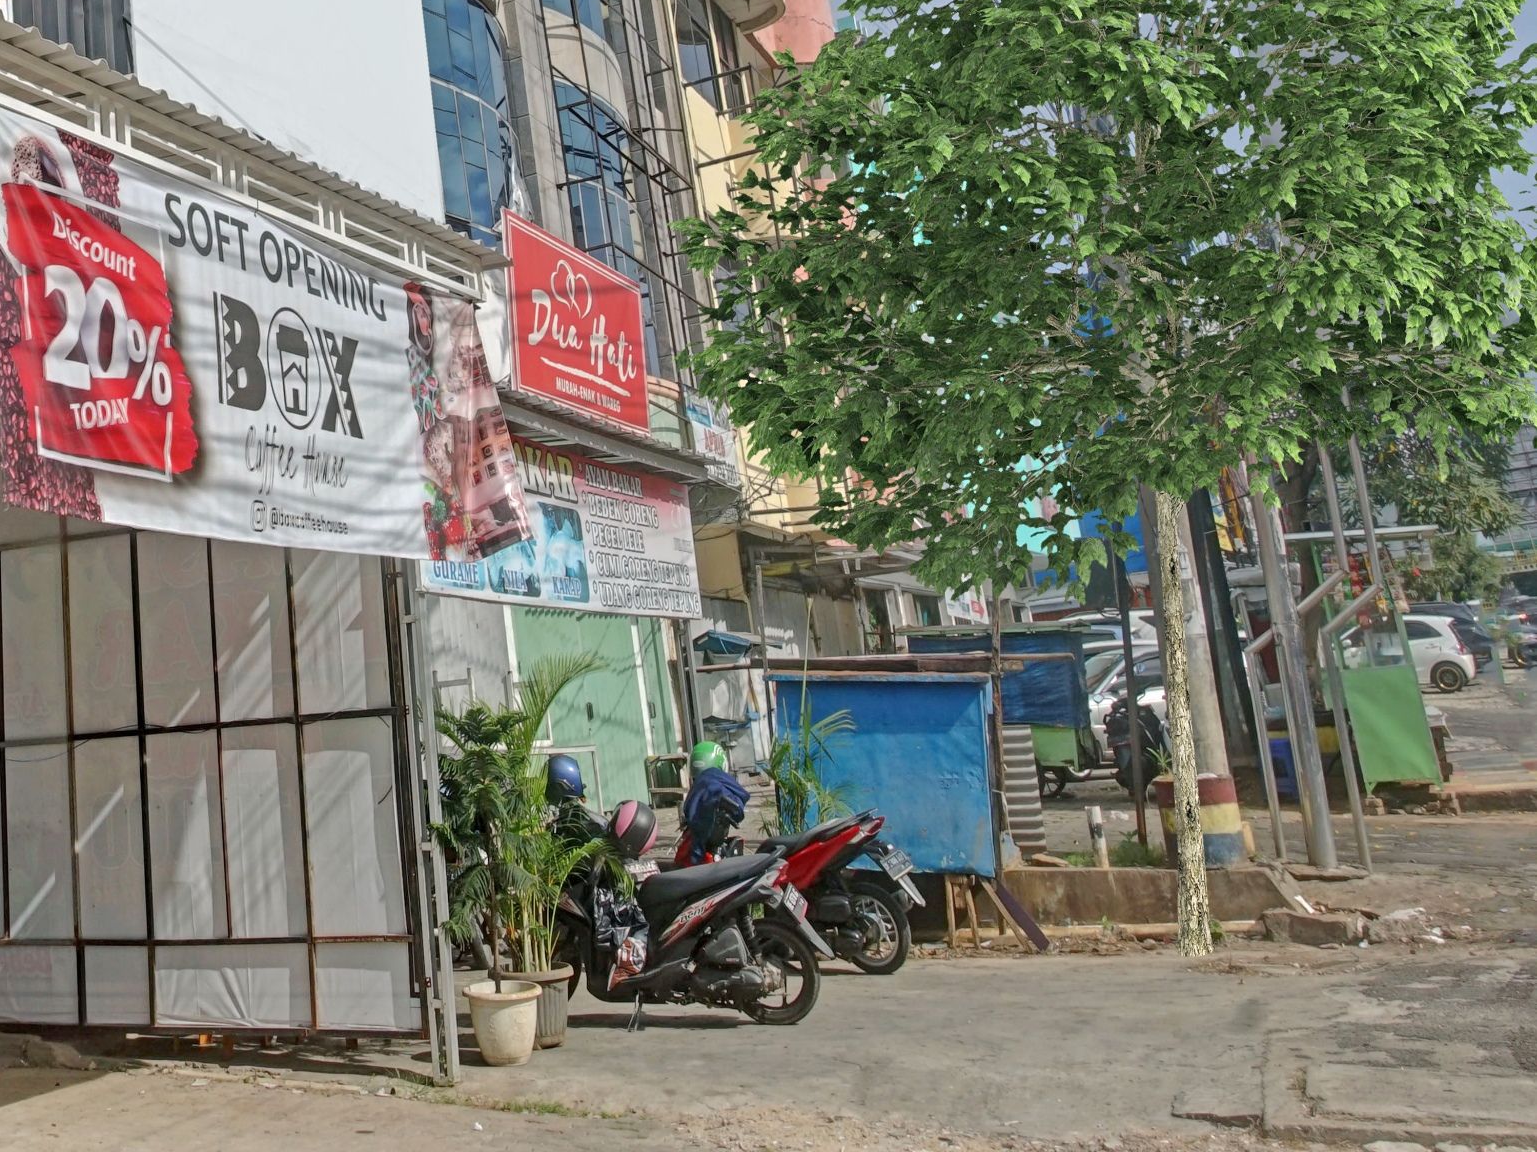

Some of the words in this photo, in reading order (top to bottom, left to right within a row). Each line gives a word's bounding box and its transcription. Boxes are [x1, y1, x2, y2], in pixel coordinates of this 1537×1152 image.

[52, 210, 136, 281] Discount
[164, 192, 248, 271] SOFT
[259, 230, 387, 322] OPENING
[43, 265, 172, 406] 20%
[528, 289, 583, 349] Dua
[590, 314, 637, 382] Hati
[213, 291, 364, 439] BOX
[556, 376, 596, 403] MURAH-ENAK
[70, 398, 129, 430] TODAY
[245, 424, 299, 496] Coffee
[302, 434, 349, 496] House
[585, 464, 610, 491] AYAM
[610, 471, 643, 498] BAKAR
[587, 492, 622, 522] BEBEK
[623, 498, 659, 529] GORENG
[591, 521, 624, 550] PECEL
[624, 527, 645, 553] LELE
[433, 560, 479, 584] GURAME
[504, 569, 527, 590] NILA
[622, 555, 659, 582] GORENG
[657, 561, 691, 587] TEPUNG
[598, 581, 633, 608] UDANG
[633, 585, 669, 611] GORENG
[667, 589, 701, 614] TEPUNG
